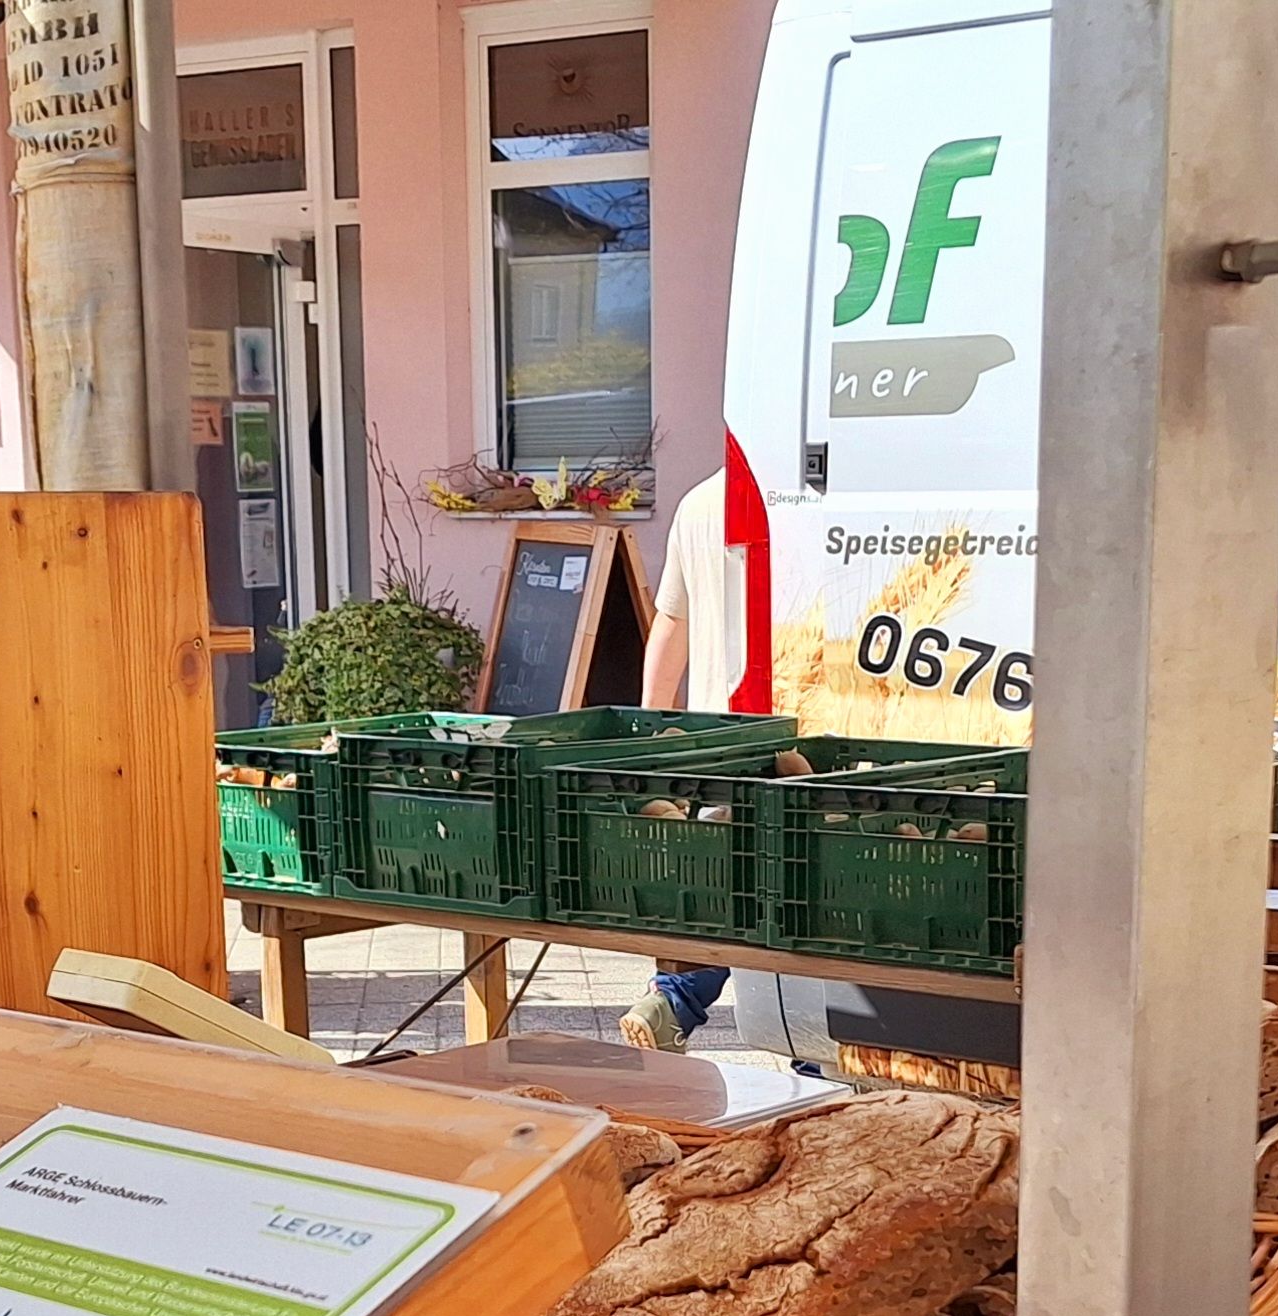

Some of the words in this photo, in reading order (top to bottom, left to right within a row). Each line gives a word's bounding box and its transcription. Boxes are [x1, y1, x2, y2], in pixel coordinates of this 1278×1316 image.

[61, 43, 119, 77] 1051
[21, 1166, 67, 1183] ARGE
[5, 1178, 85, 1204] Marktfahrer
[266, 1213, 307, 1232] LE
[305, 1222, 372, 1247] 07-13
